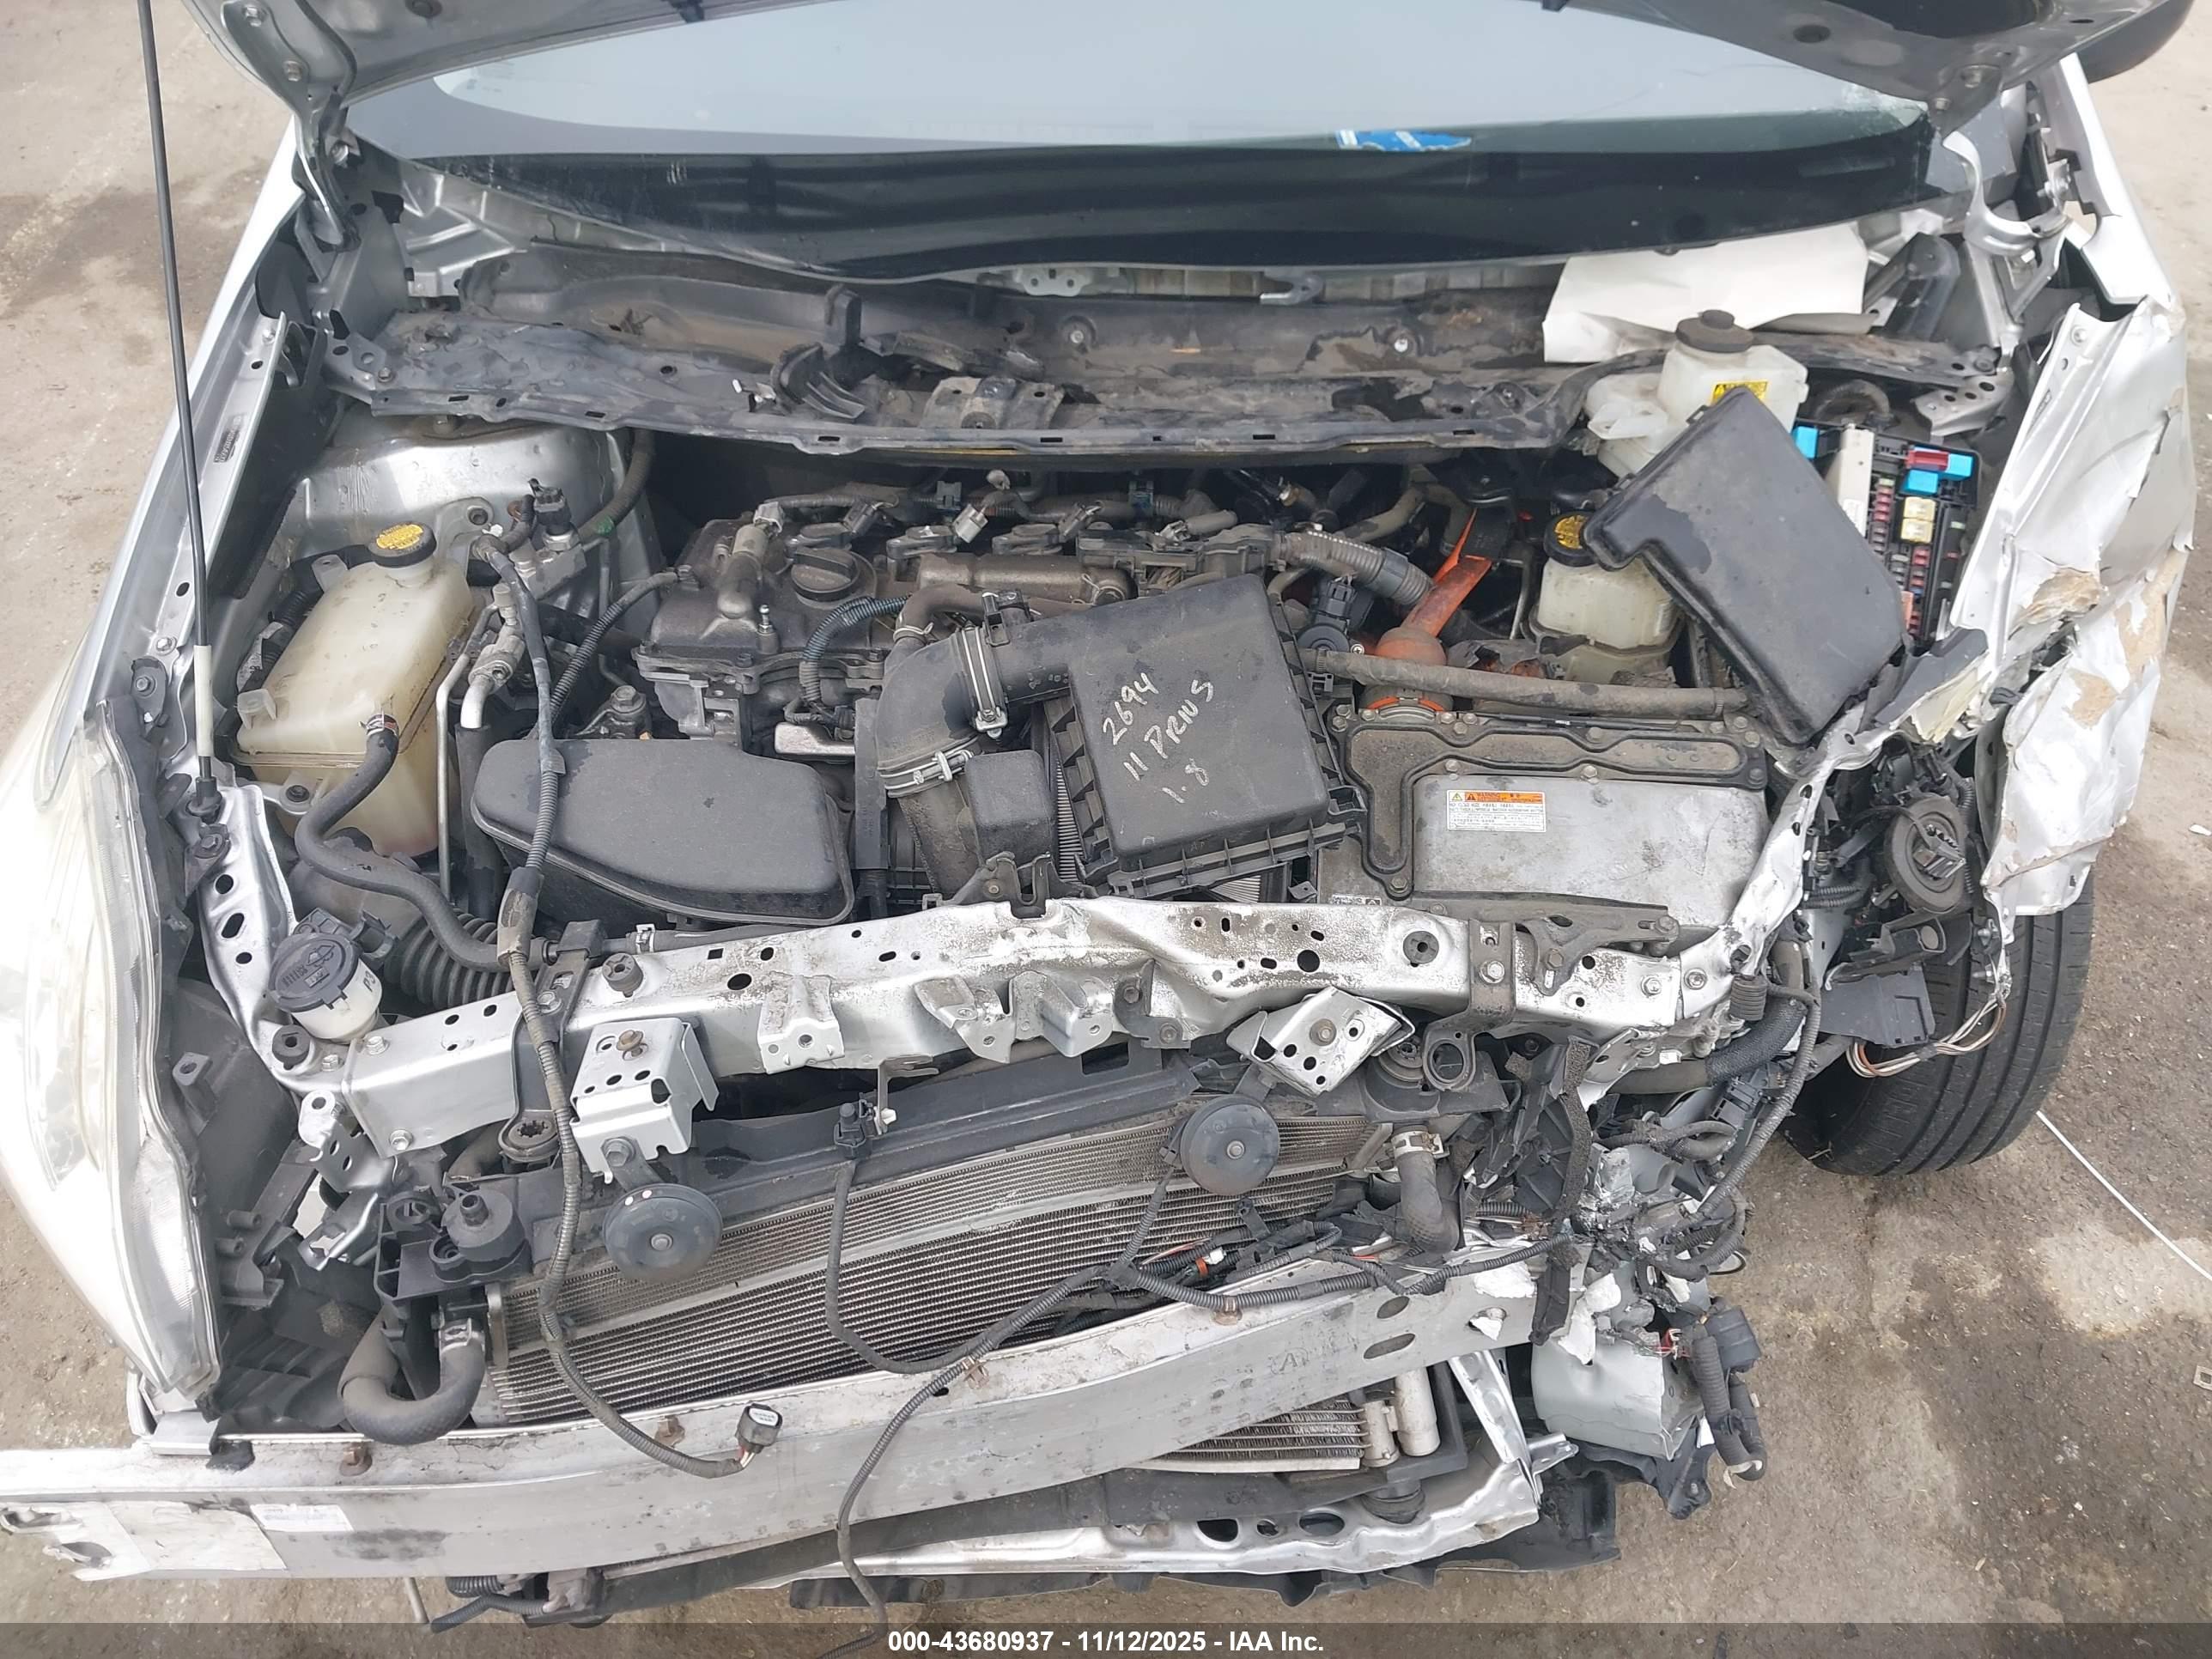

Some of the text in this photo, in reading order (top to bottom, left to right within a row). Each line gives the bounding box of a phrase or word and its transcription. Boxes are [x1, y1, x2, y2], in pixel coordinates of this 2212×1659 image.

[1103, 672, 1159, 745] 2694
[1145, 679, 1213, 759] PRIUS
[1162, 758, 1209, 804] 1.8
